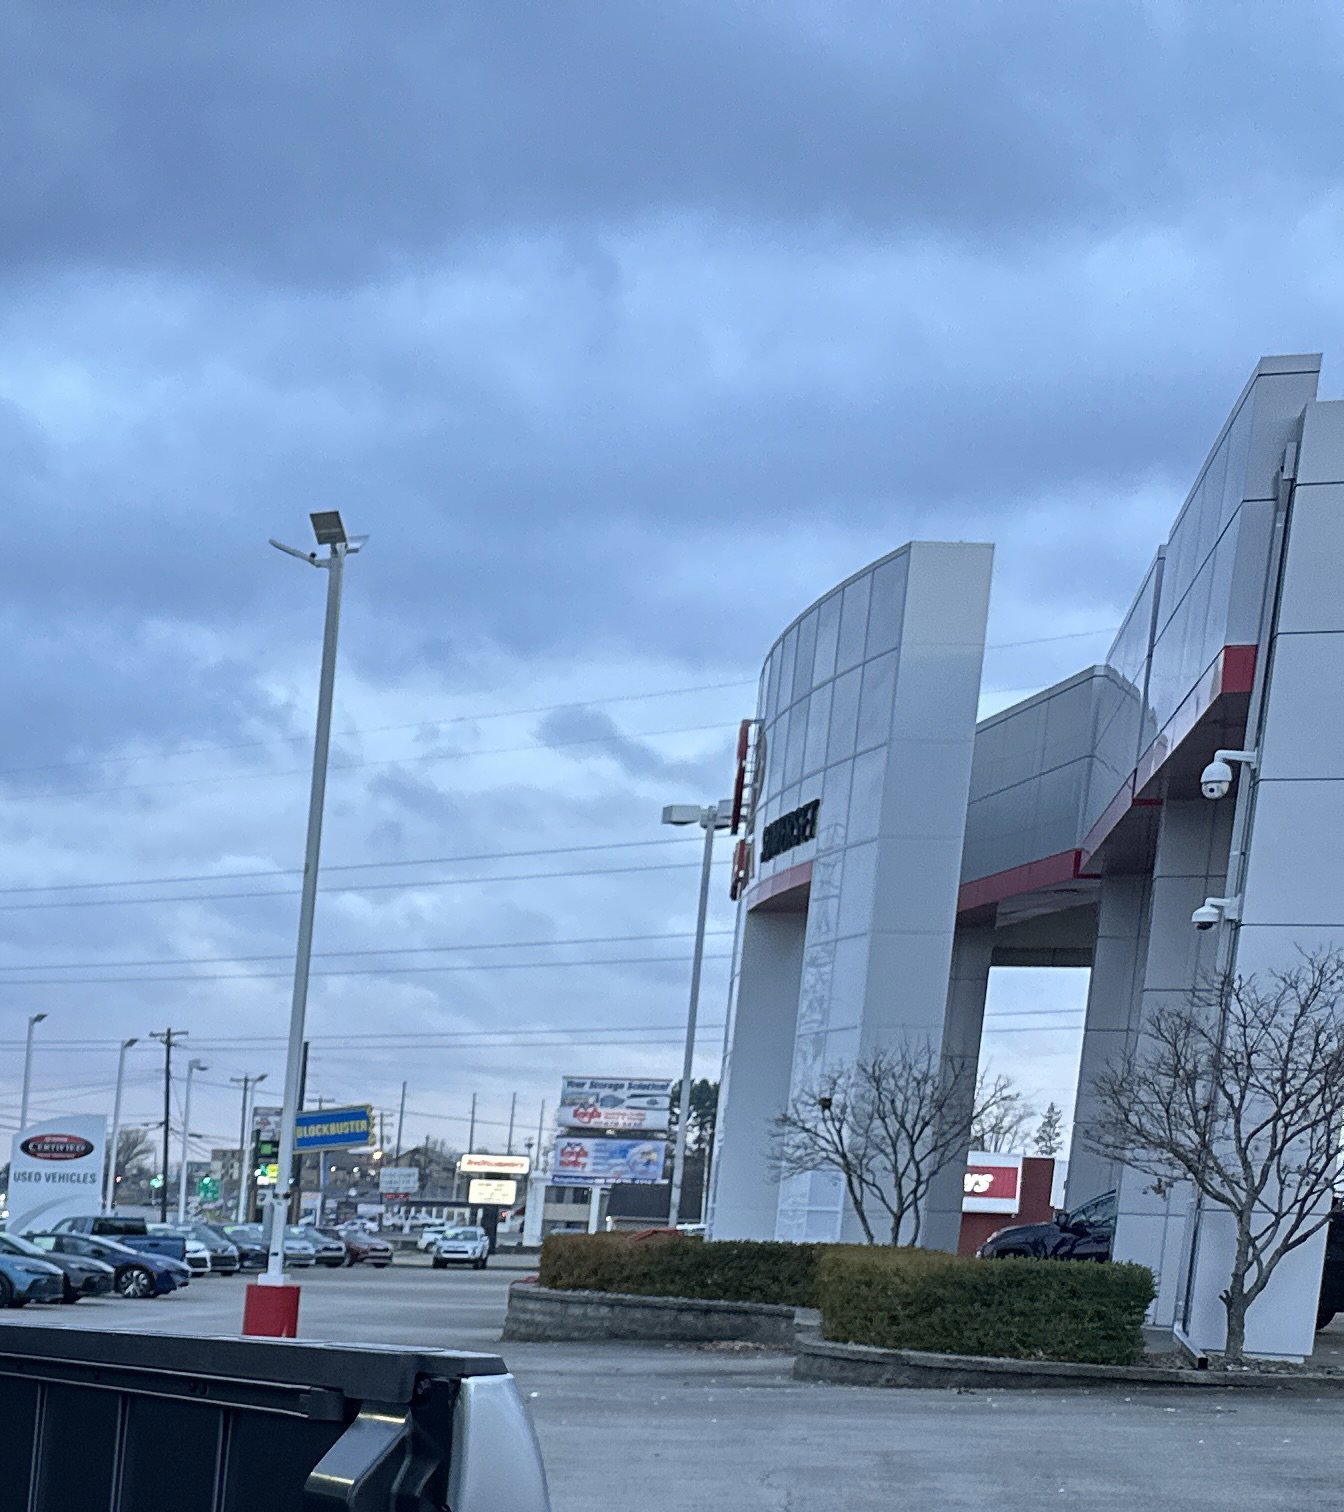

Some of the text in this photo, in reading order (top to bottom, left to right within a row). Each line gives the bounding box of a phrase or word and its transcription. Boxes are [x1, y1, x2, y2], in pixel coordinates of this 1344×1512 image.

[296, 1120, 368, 1139] BLOCKBUSTER
[13, 1171, 97, 1185] USED VEHICLES
